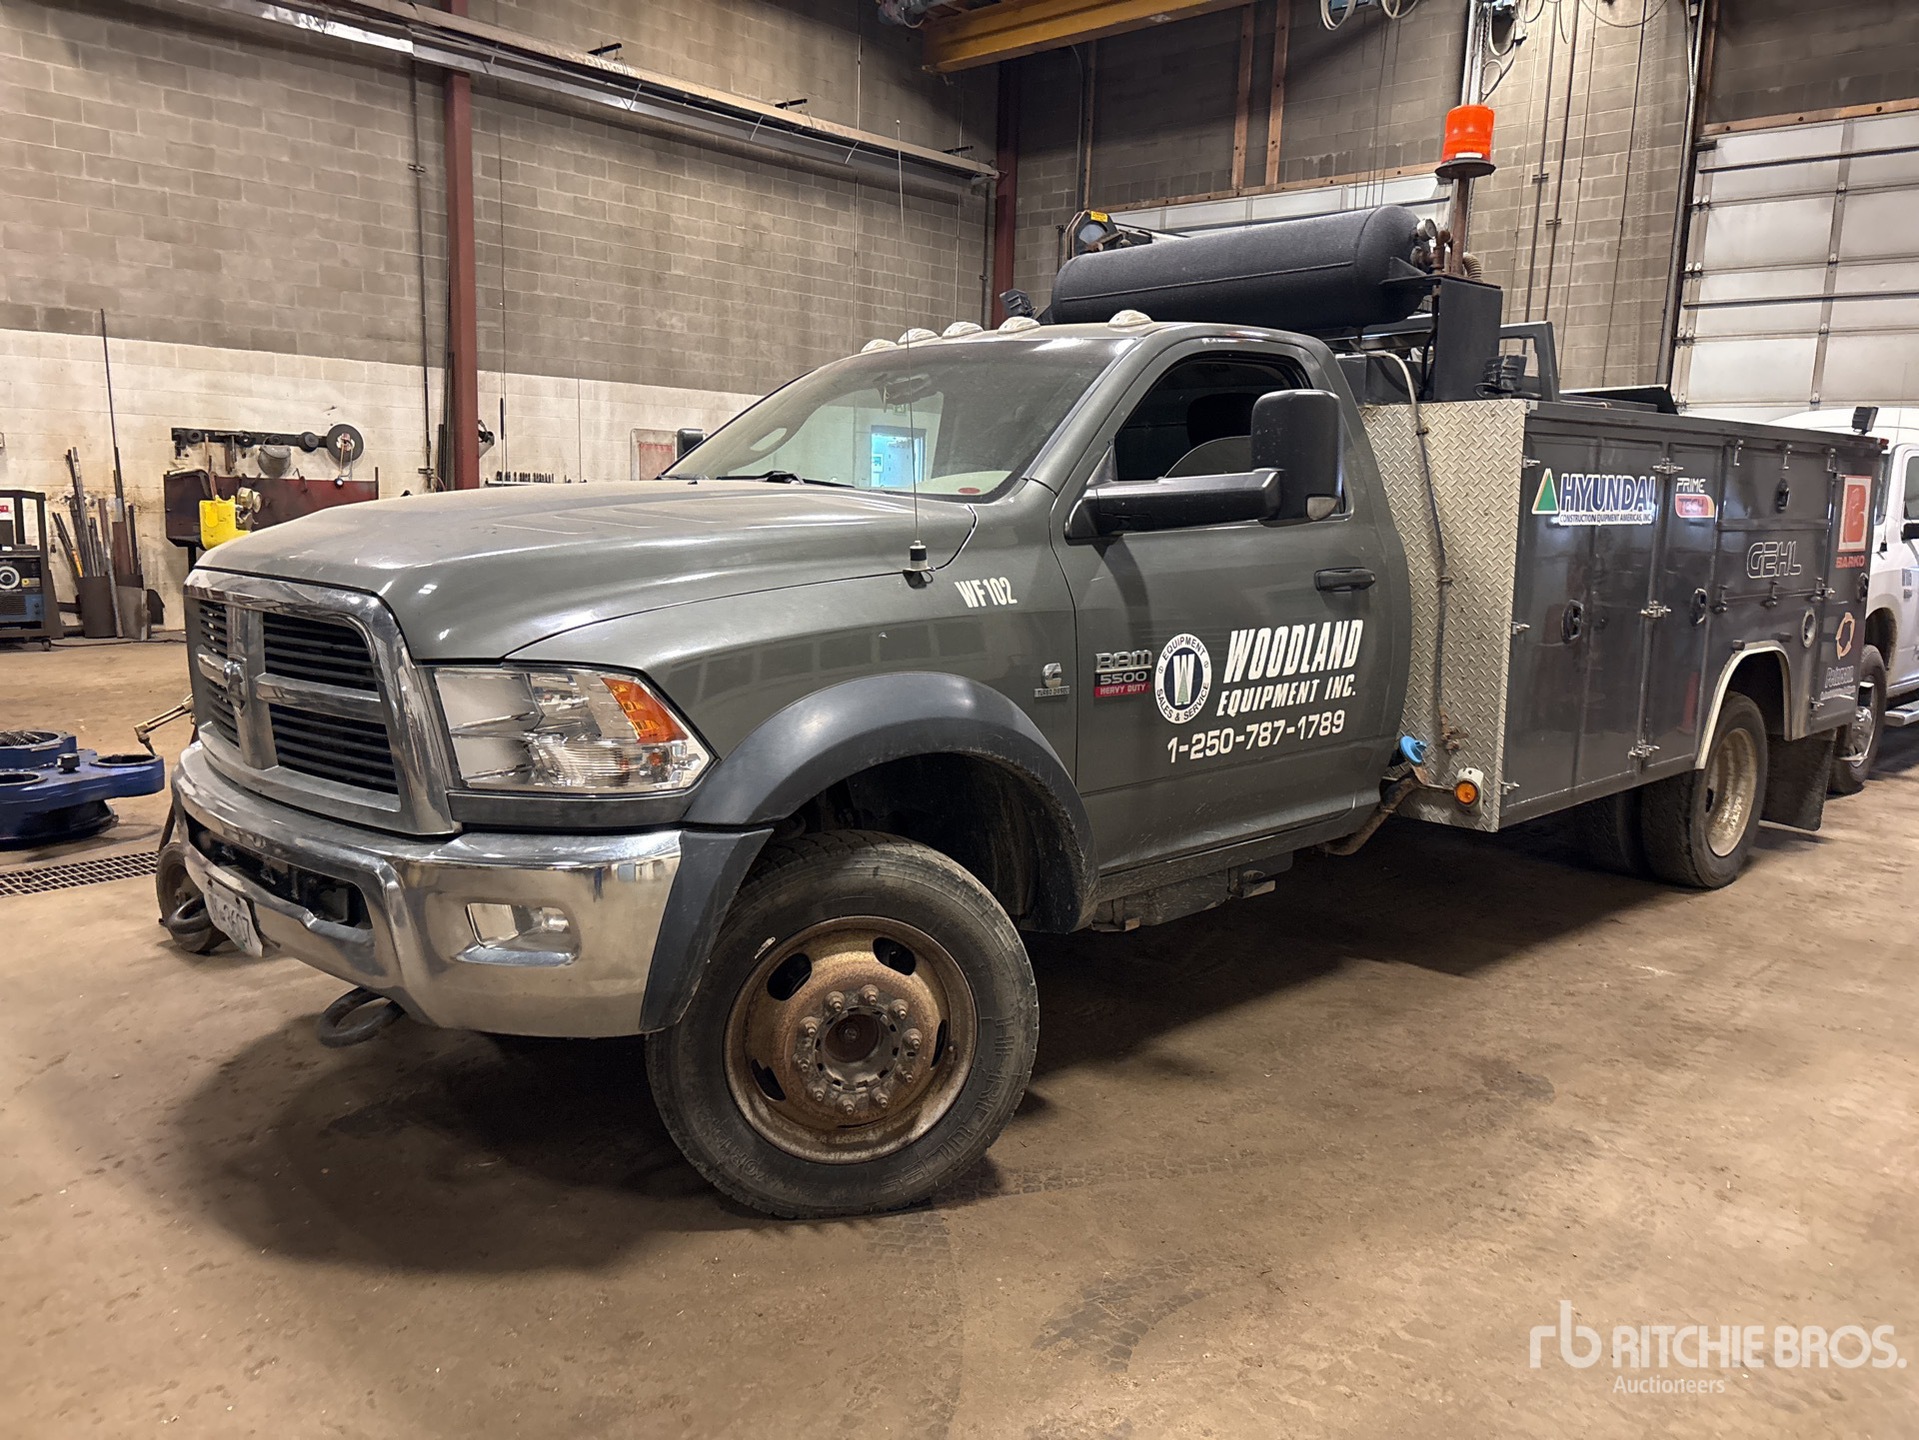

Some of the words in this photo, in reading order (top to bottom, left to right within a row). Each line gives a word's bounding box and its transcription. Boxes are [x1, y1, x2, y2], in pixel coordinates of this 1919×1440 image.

[1560, 473, 1656, 513] HYUNDAI
[1676, 477, 1706, 494] PRIME
[1560, 513, 1596, 523] CONSTRUCTION
[1597, 514, 1619, 525] EQUIPMENT
[1746, 541, 1801, 578] GEHL
[1836, 555, 1865, 569] BARKO
[1095, 650, 1153, 670] RAM
[1162, 636, 1206, 661] EQUIPMENT
[1222, 619, 1364, 684] WOODLAND
[1100, 670, 1147, 685] 5500
[1100, 685, 1125, 696] HEAVY
[1128, 683, 1146, 693] DUTY
[1157, 688, 1173, 719] SALES
[1174, 712, 1181, 721] &
[1183, 682, 1209, 721] SERVICE
[1216, 678, 1320, 718] EQUIPMENT
[1324, 673, 1356, 700] INC.
[1167, 709, 1345, 764] 1-250-787-1789
